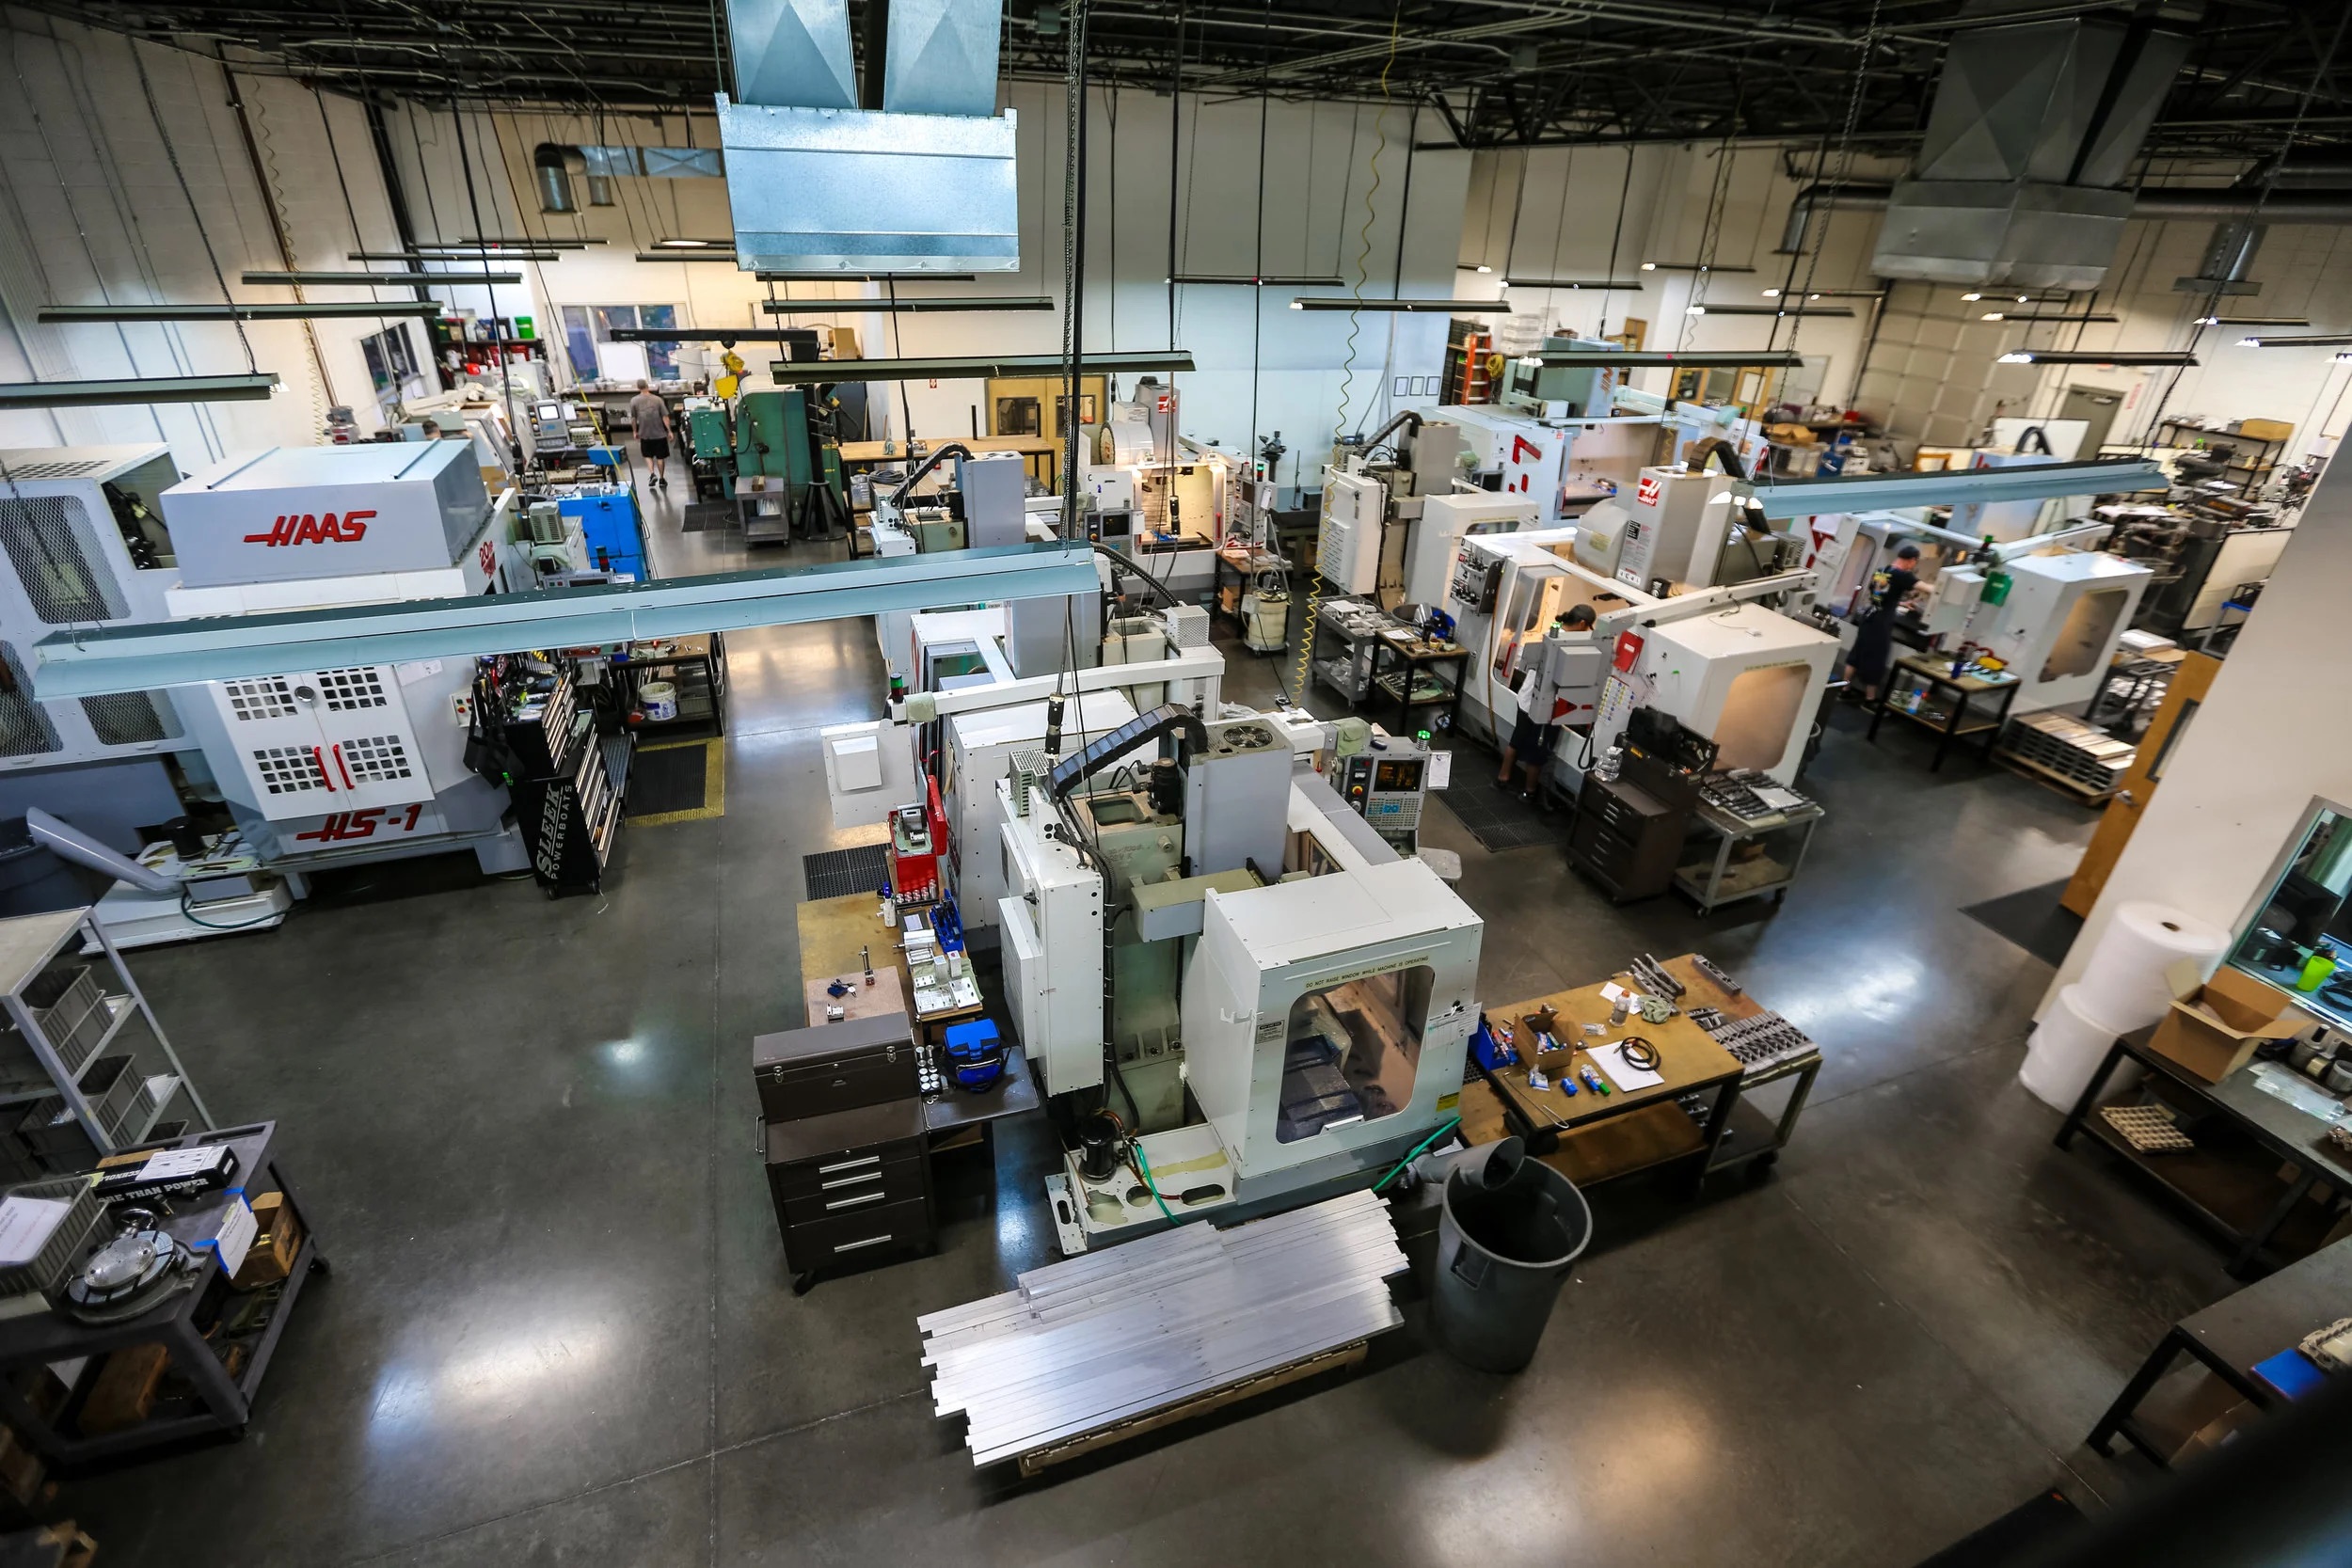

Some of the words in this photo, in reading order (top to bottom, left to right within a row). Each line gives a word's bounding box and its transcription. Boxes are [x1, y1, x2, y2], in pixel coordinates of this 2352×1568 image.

[244, 511, 377, 546] HAAS
[296, 803, 422, 842] HS-1
[536, 783, 560, 878] SLEEK
[551, 784, 572, 879] POWERBOATS
[1341, 972, 1360, 980] WINDOW
[1377, 963, 1397, 972] MACHINE
[1405, 956, 1429, 966] OPERATING
[125, 1186, 163, 1199] THAN
[163, 1178, 210, 1192] POWER
